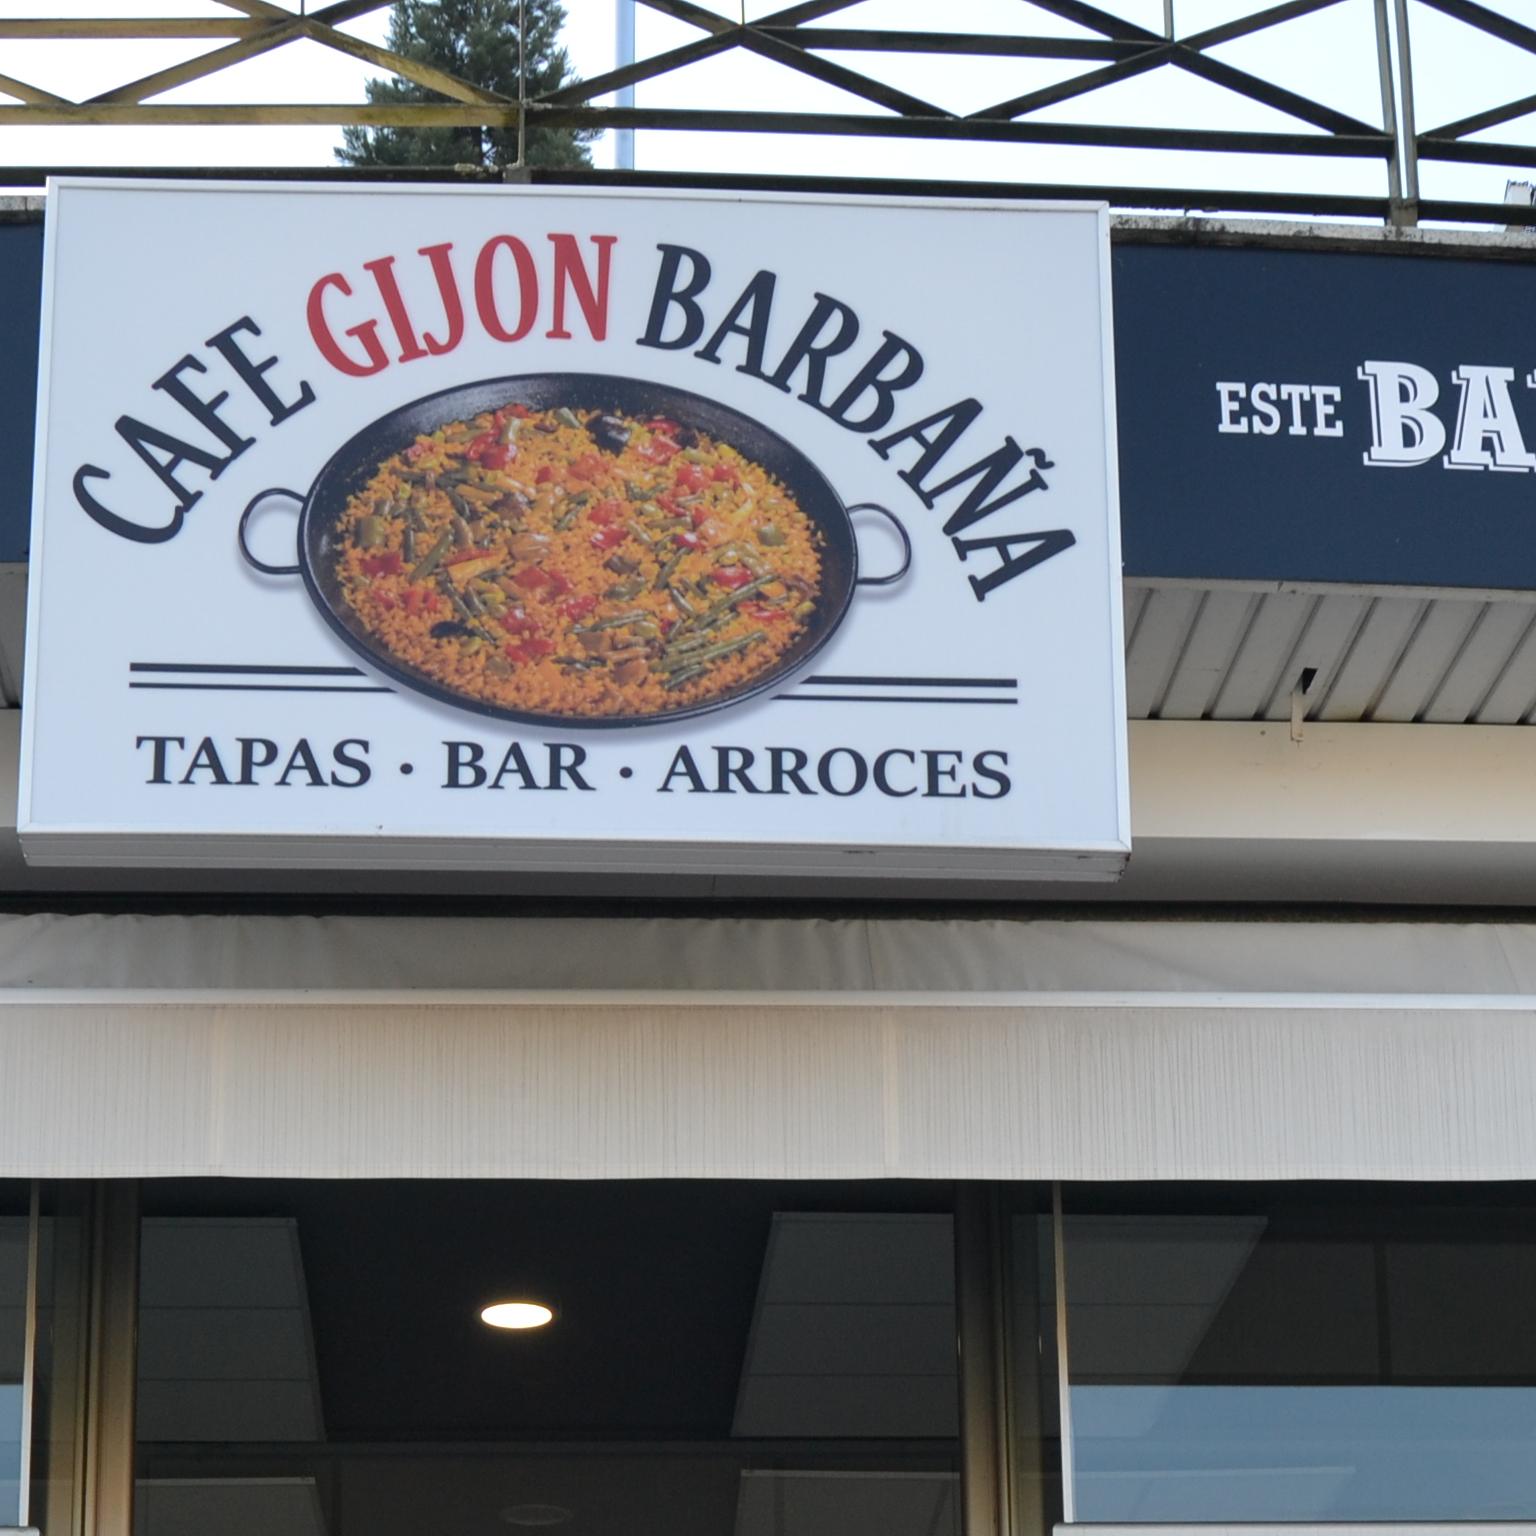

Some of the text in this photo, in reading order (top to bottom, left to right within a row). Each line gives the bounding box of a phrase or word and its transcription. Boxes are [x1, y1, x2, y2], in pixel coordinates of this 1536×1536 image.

[72, 232, 1077, 602] CAFE GIJON BARBAÑA
[1216, 381, 1344, 438] ESTE
[136, 734, 1013, 800] TAPAS BAR ARROCES
